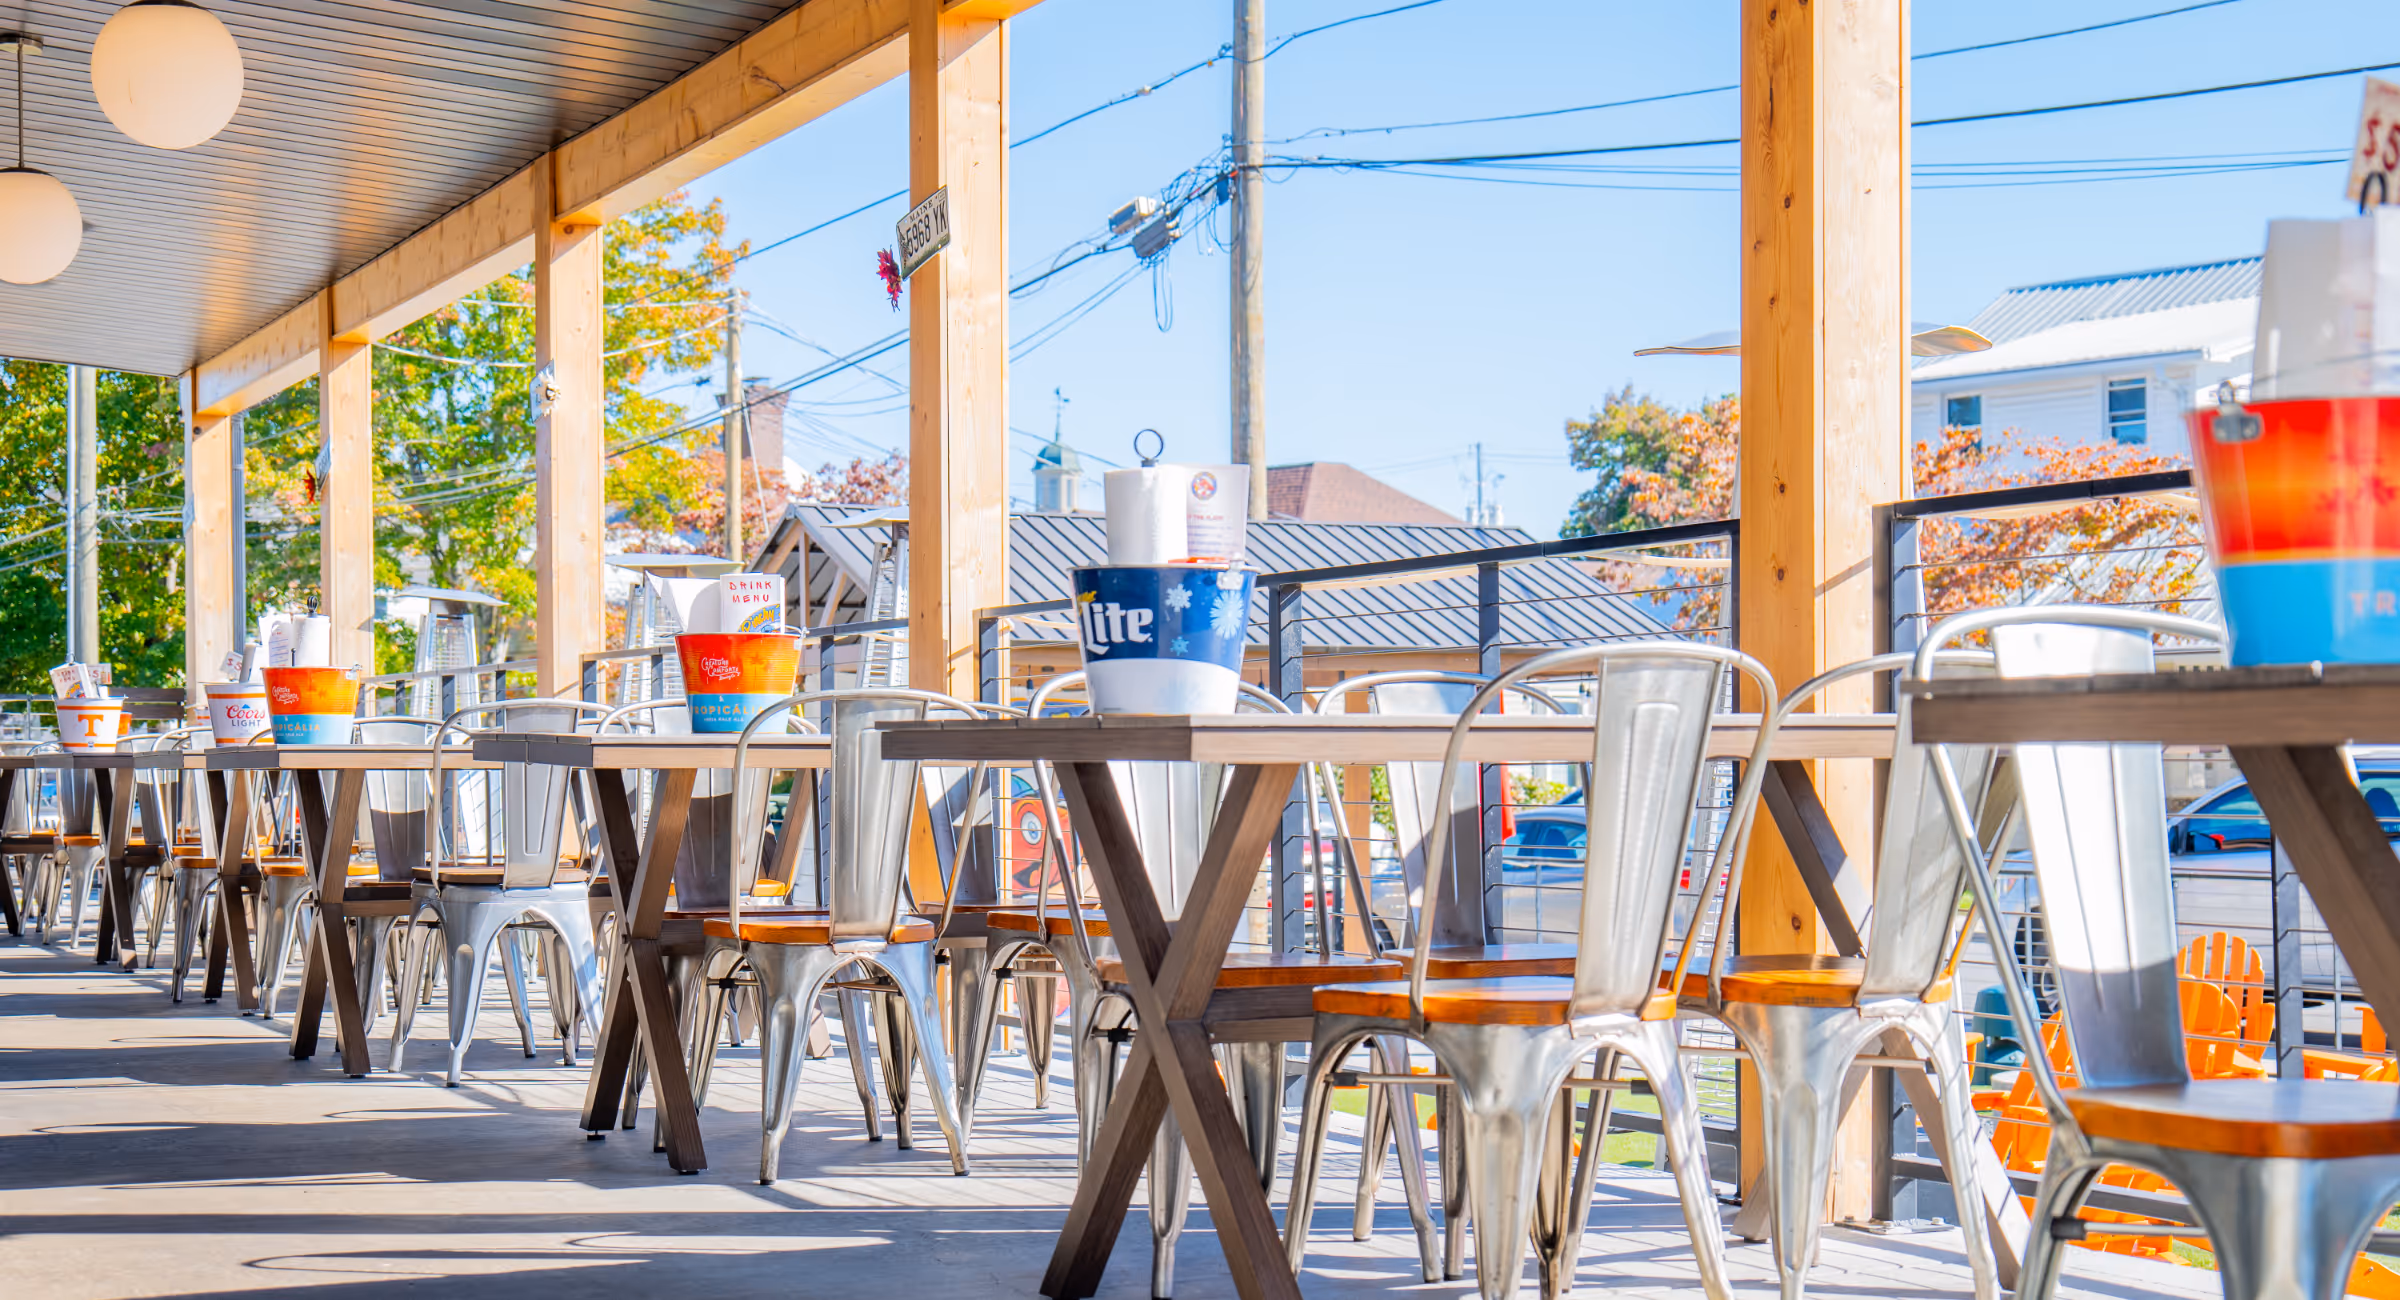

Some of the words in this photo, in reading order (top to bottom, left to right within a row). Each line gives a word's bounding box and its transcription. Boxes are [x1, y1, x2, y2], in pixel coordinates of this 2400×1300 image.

[909, 199, 934, 223] MAINE
[906, 213, 932, 257] 5968
[933, 200, 948, 235] YK
[729, 581, 772, 590] DRINK
[732, 594, 769, 603] MENU
[1080, 602, 1153, 656] Lite
[226, 704, 266, 719] Coors
[78, 714, 104, 737] T
[231, 719, 261, 727] LIGHT
